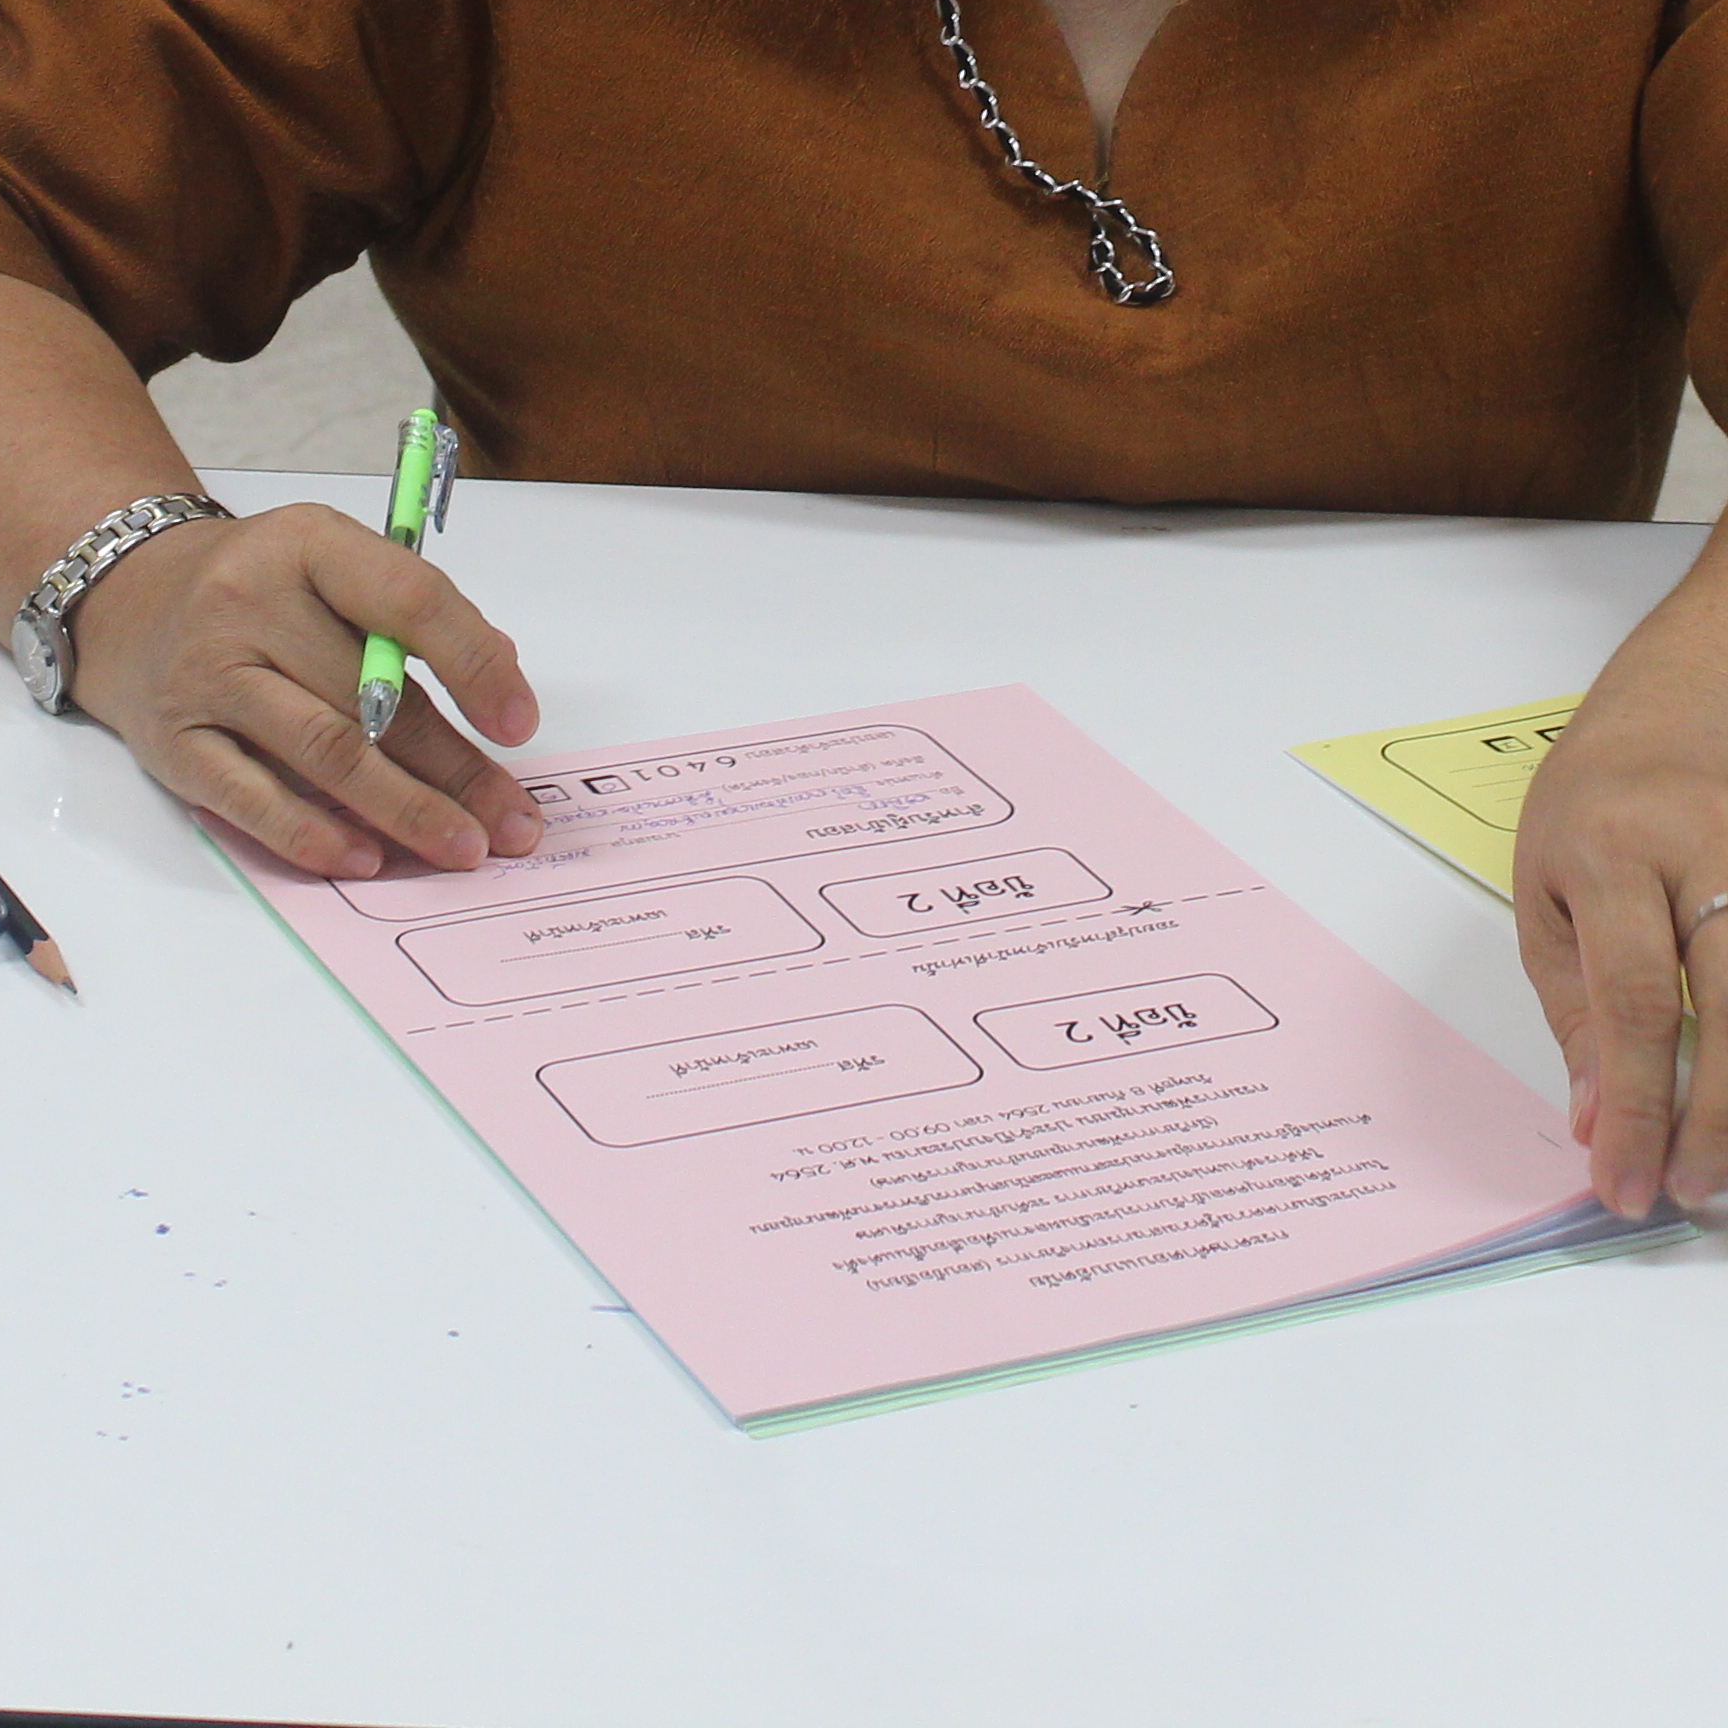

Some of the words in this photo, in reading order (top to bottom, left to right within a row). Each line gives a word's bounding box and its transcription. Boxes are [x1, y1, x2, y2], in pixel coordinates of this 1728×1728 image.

[806, 804, 985, 839] สำหรับผู้เข้าสอบ
[898, 893, 933, 912] 2
[940, 876, 1034, 914] ข้อที่
[523, 910, 667, 944] เฉพาะเจ้าหน้าที่
[912, 920, 1179, 977] รอยปรุสำหรับเจ้าหน้าที่เท่านั้น
[1055, 1021, 1093, 1043] 2
[1099, 1004, 1197, 1045] ข้อที่
[669, 1040, 818, 1079] เฉพาะเจ้าหน้าที่
[1129, 1087, 1145, 1096] 8
[1148, 1074, 1212, 1095] วันพุธที่
[998, 1104, 1050, 1120] 2564
[1075, 1083, 1269, 1125] กรมการพัฒนาชุมชน
[890, 1123, 950, 1141] 09.00
[954, 1114, 993, 1127] เวลา
[818, 1137, 873, 1153] 12.00
[882, 1120, 1073, 1161] ประจำปีงบประมาณ
[770, 1164, 831, 1182] 2564
[866, 1259, 991, 1291] (สอบข้อเขียน)
[1029, 1230, 1289, 1288] กระดาษคำตอบแบบอัตนัย
